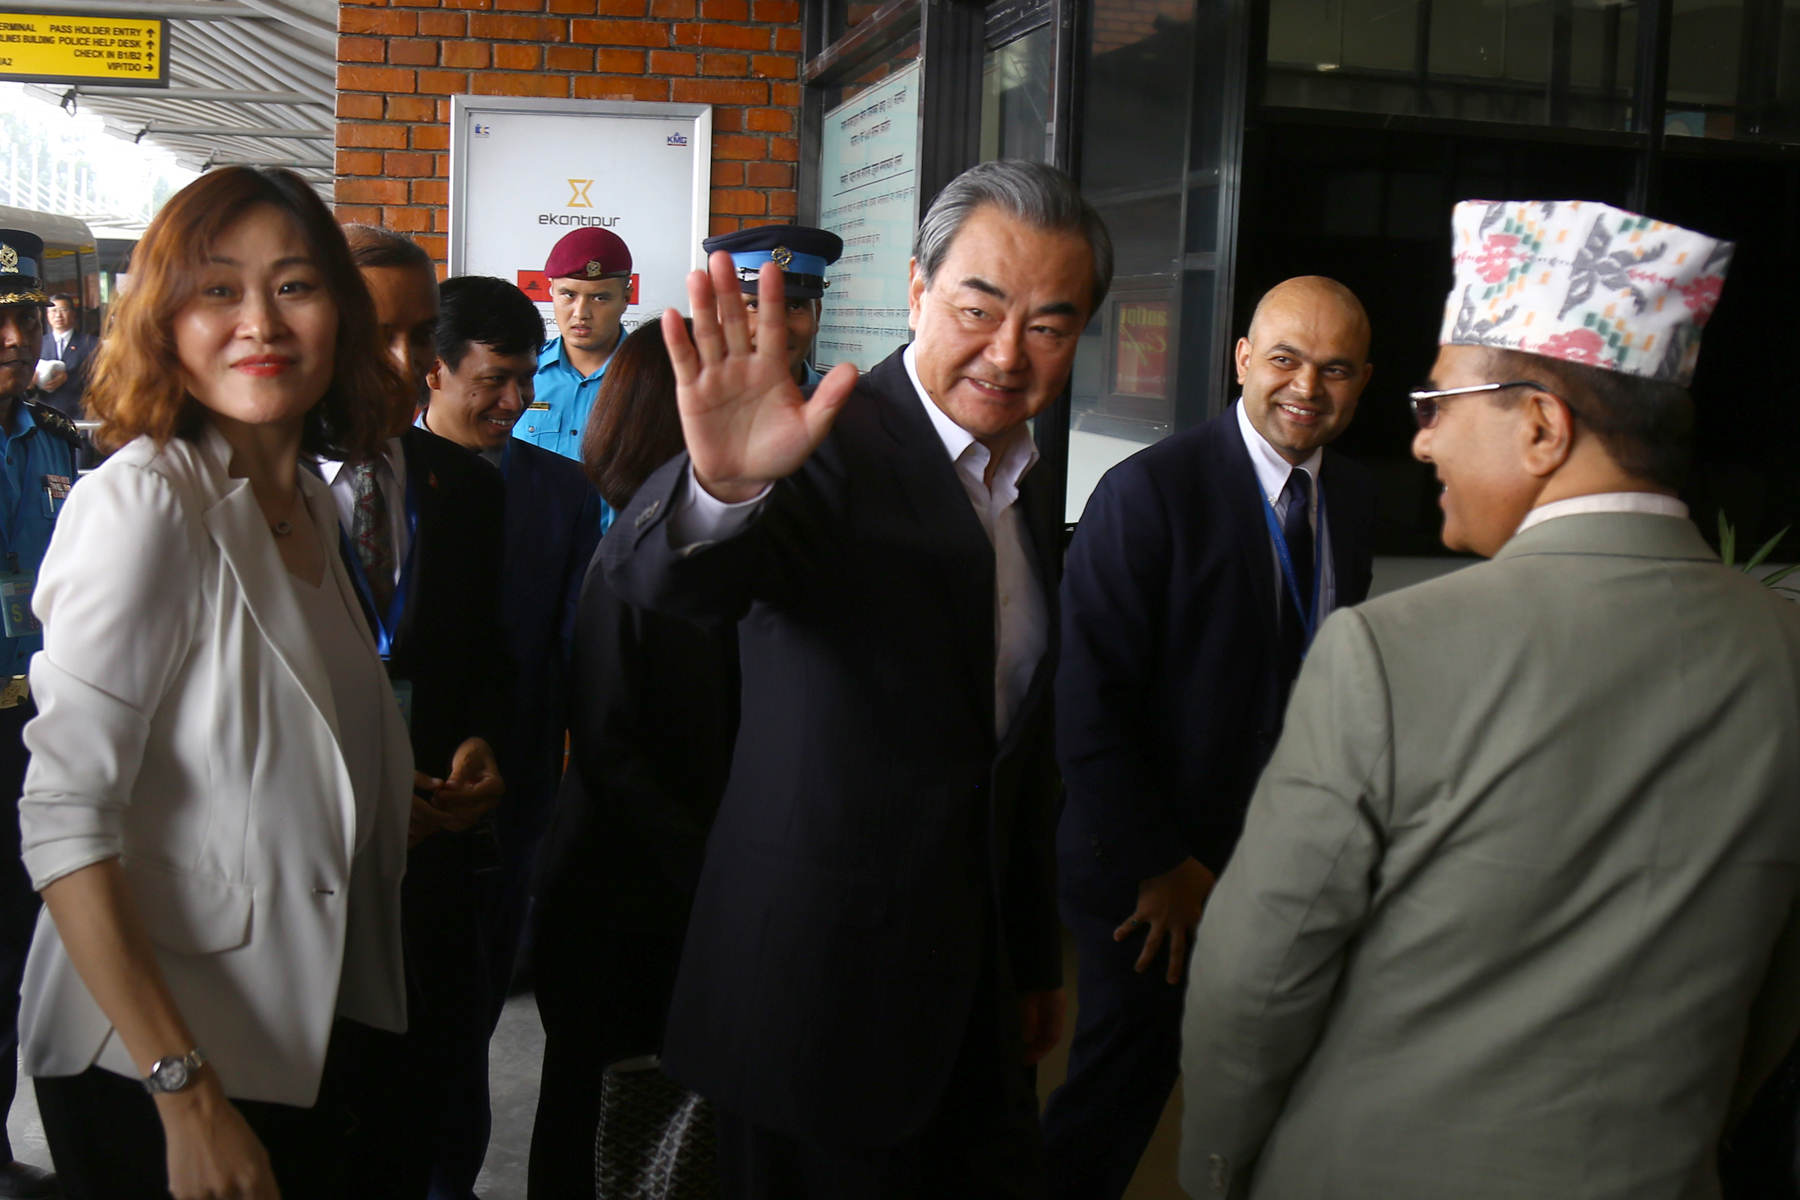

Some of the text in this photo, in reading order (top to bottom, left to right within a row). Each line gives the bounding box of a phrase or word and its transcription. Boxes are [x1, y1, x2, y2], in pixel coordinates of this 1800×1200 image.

[50, 24, 142, 36] PASS HOLDER ENTRY
[23, 35, 55, 44] BUILDING
[59, 36, 142, 48] POLICE HELP DESK
[74, 49, 142, 60] CHECK IN B1/B2
[667, 135, 688, 144] KMG
[538, 212, 621, 227] ekantipur
